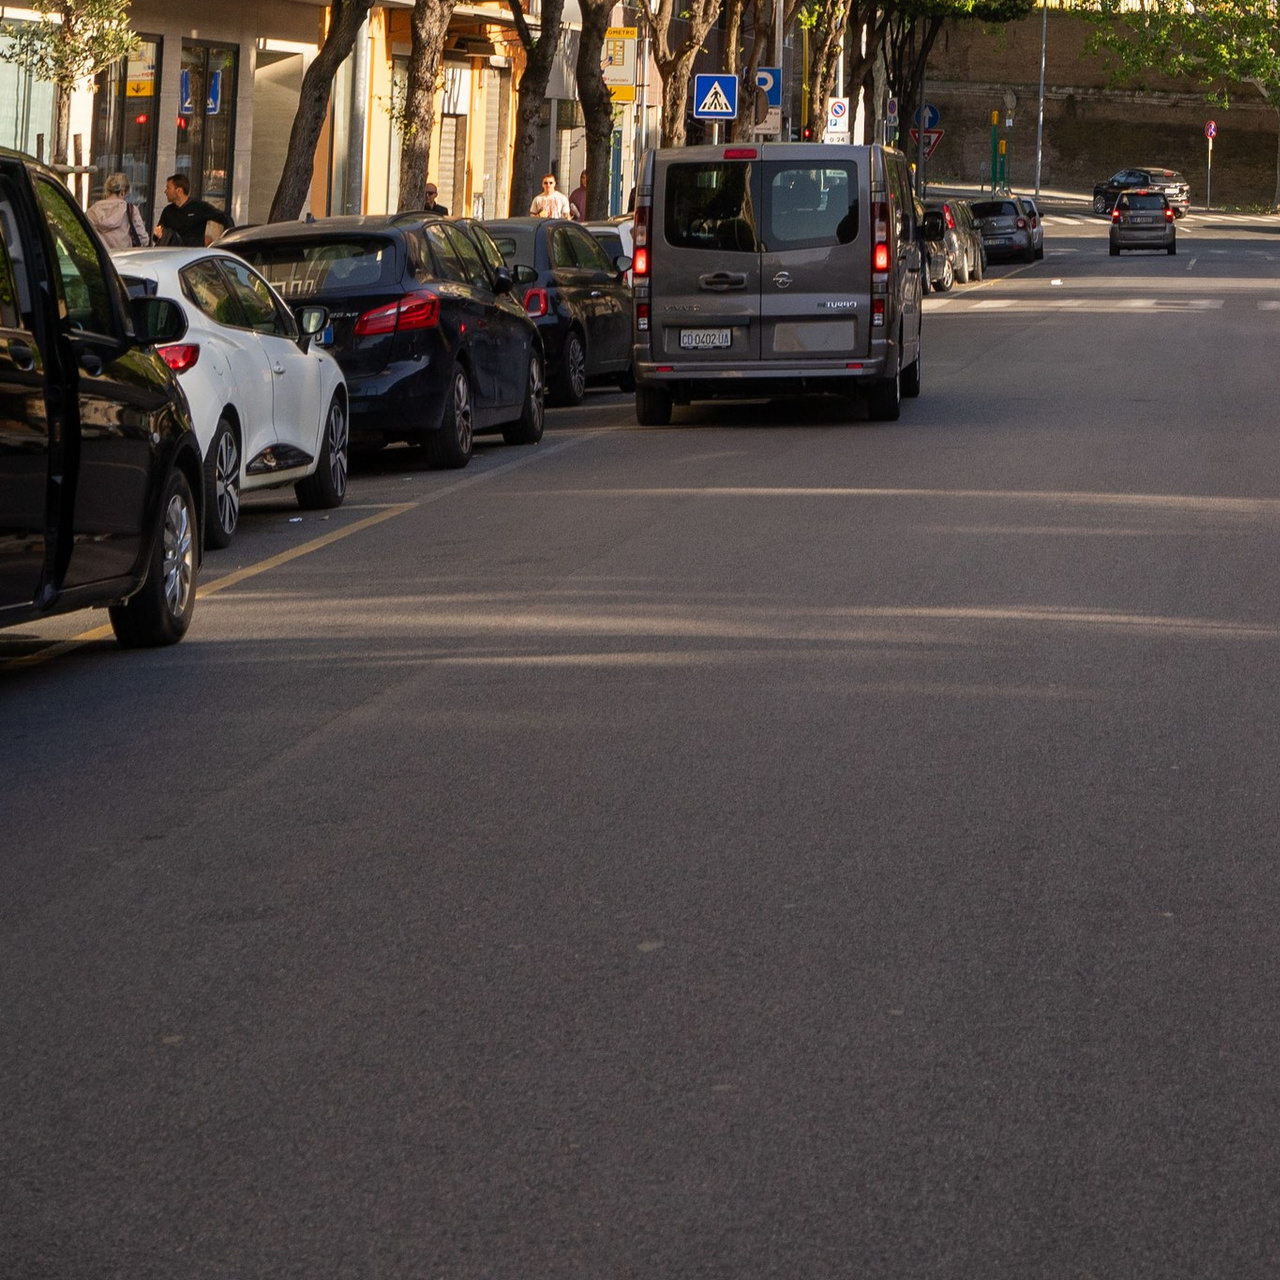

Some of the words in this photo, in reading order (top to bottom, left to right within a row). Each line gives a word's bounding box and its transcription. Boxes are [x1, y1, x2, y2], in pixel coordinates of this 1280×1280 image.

[682, 334, 693, 345] CD
[694, 333, 717, 345] 0402
[718, 333, 729, 344] UA
